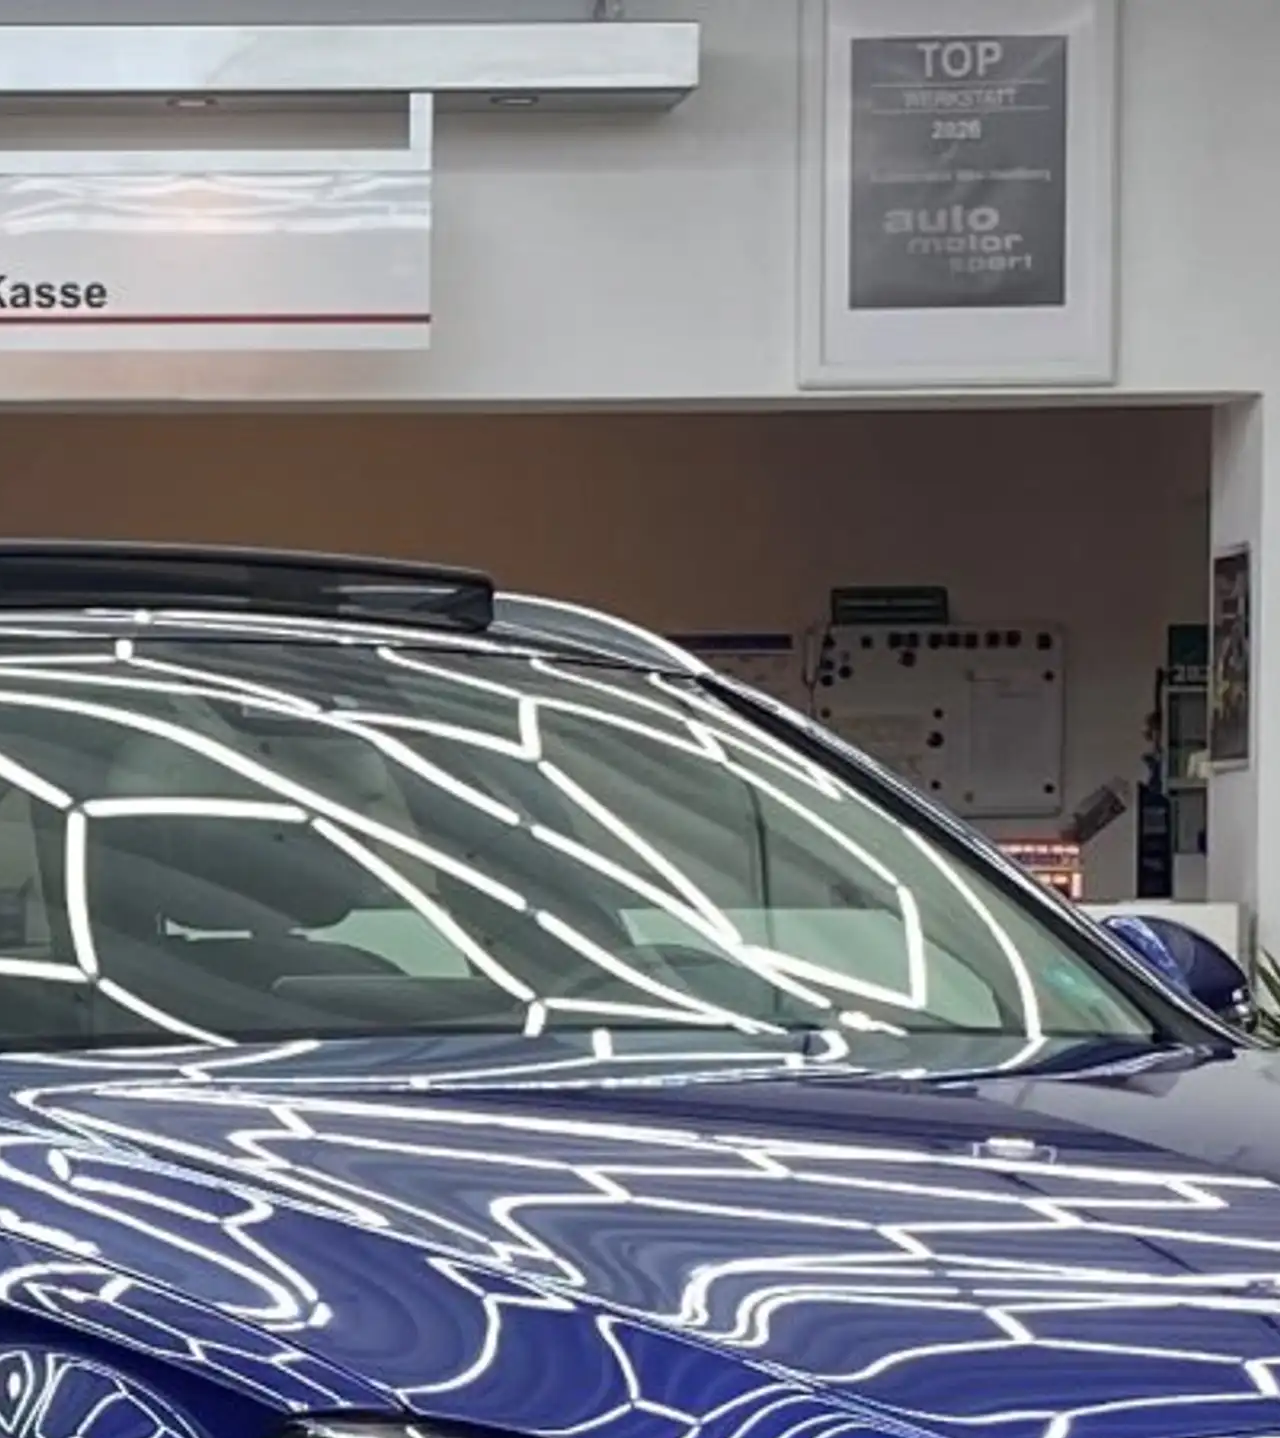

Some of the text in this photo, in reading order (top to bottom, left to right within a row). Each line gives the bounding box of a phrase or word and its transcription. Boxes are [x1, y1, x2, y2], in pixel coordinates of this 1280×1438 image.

[916, 41, 1003, 78] TOP
[882, 204, 1000, 234] auto
[907, 234, 1024, 255] motor
